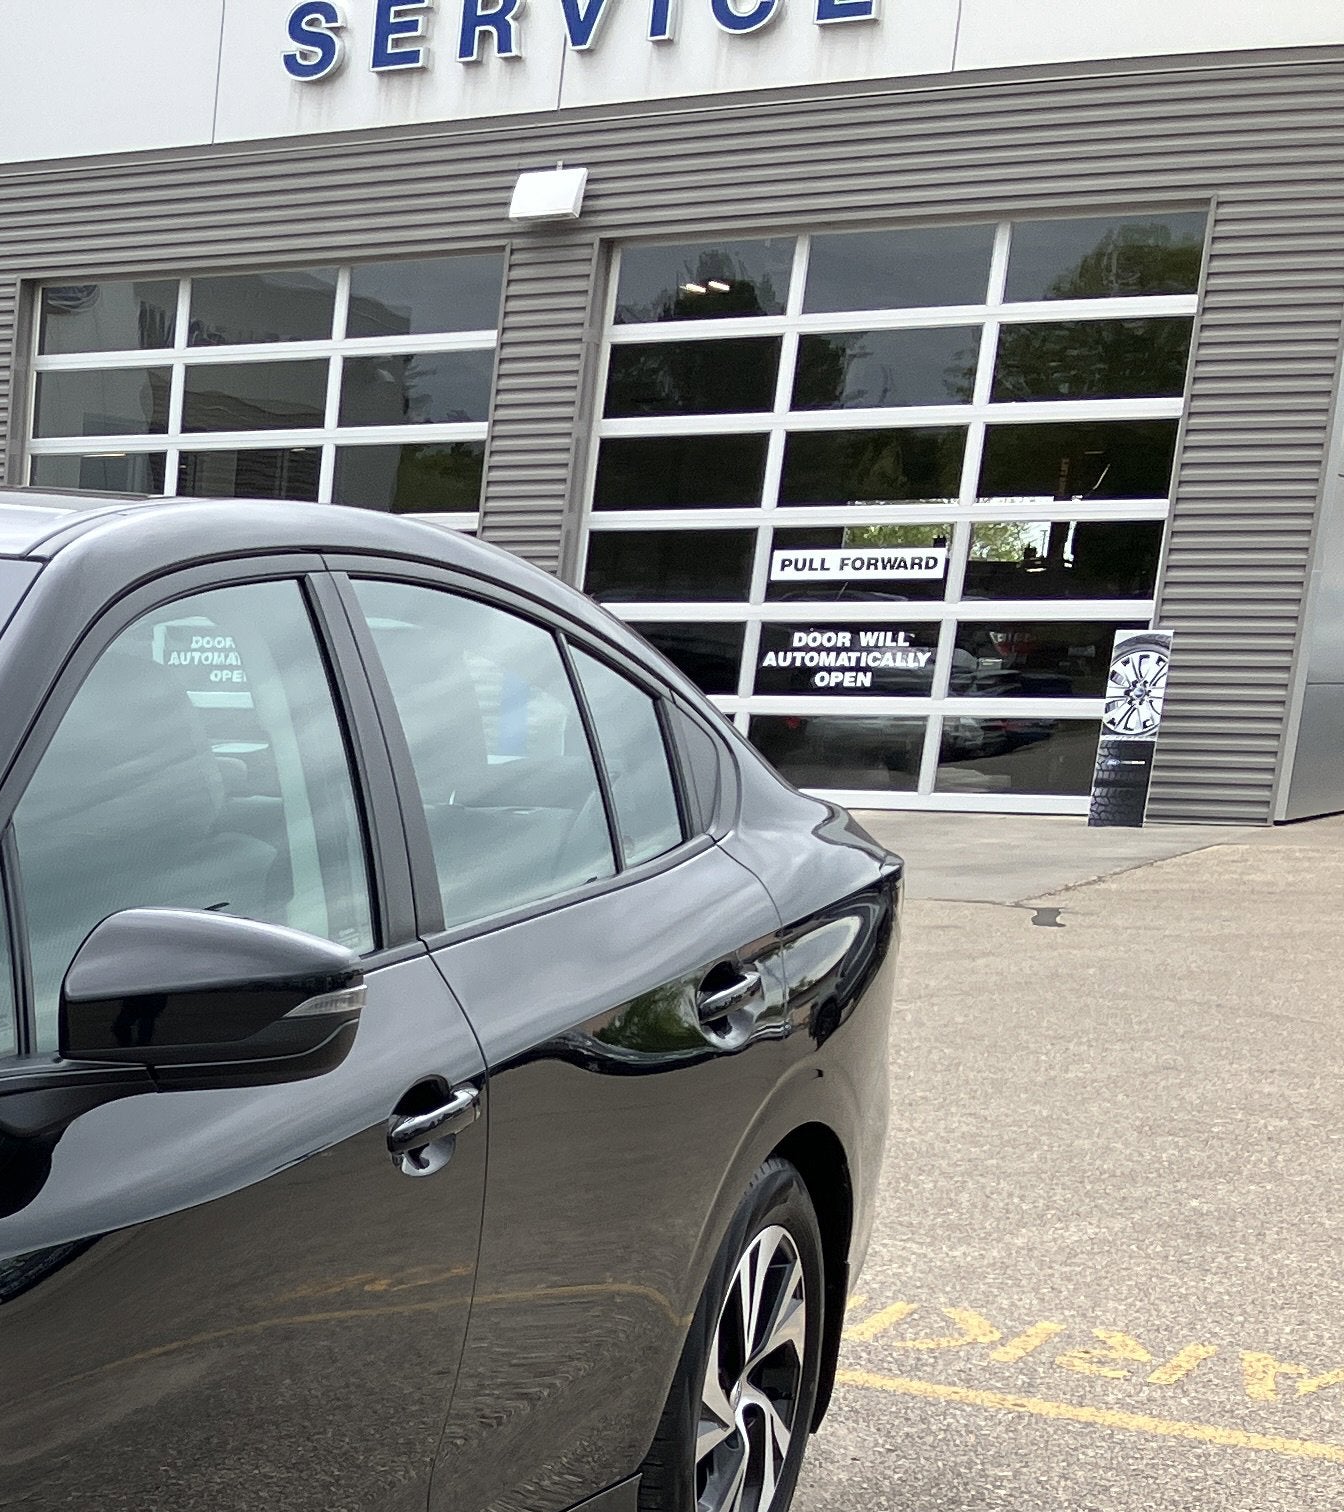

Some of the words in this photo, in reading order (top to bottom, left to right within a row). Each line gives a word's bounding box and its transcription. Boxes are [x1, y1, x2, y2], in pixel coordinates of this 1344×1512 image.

[780, 558, 830, 571] PULL
[839, 556, 938, 571] FORWARD
[793, 632, 852, 647] DOOR
[859, 632, 910, 647] WILL
[763, 652, 932, 667] AUTOMATICALLY
[210, 670, 247, 682] OPE
[814, 672, 872, 687] OPEN
